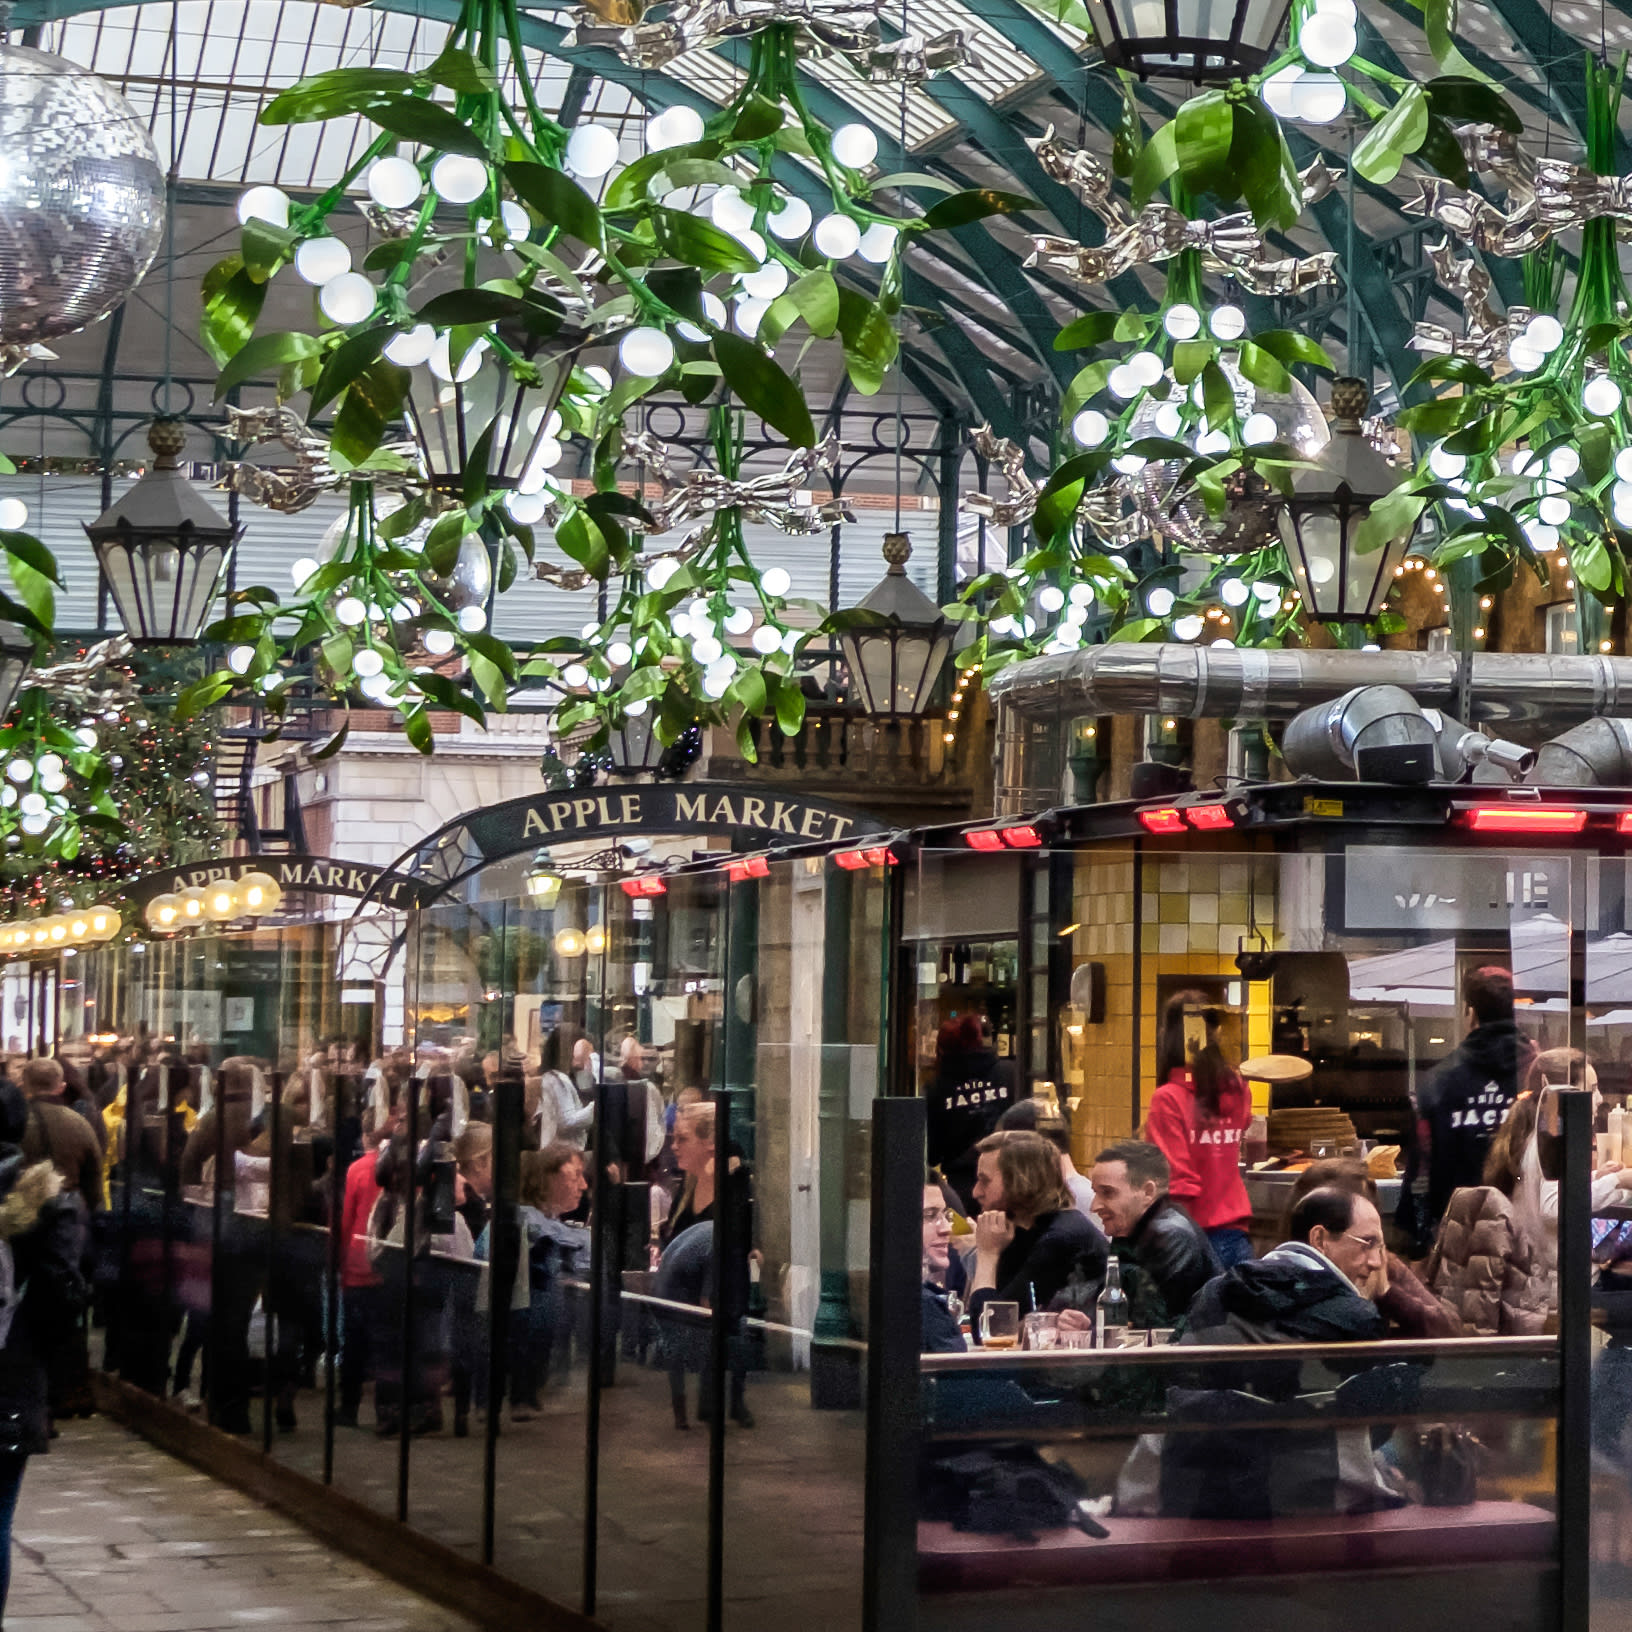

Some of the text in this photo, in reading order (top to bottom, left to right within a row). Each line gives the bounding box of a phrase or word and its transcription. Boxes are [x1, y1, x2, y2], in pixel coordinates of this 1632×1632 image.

[522, 792, 854, 841] APPLE MARKET
[172, 862, 408, 901] APP MARKT
[945, 1086, 1008, 1110] JACKS
[1451, 1108, 1510, 1128] JAC
